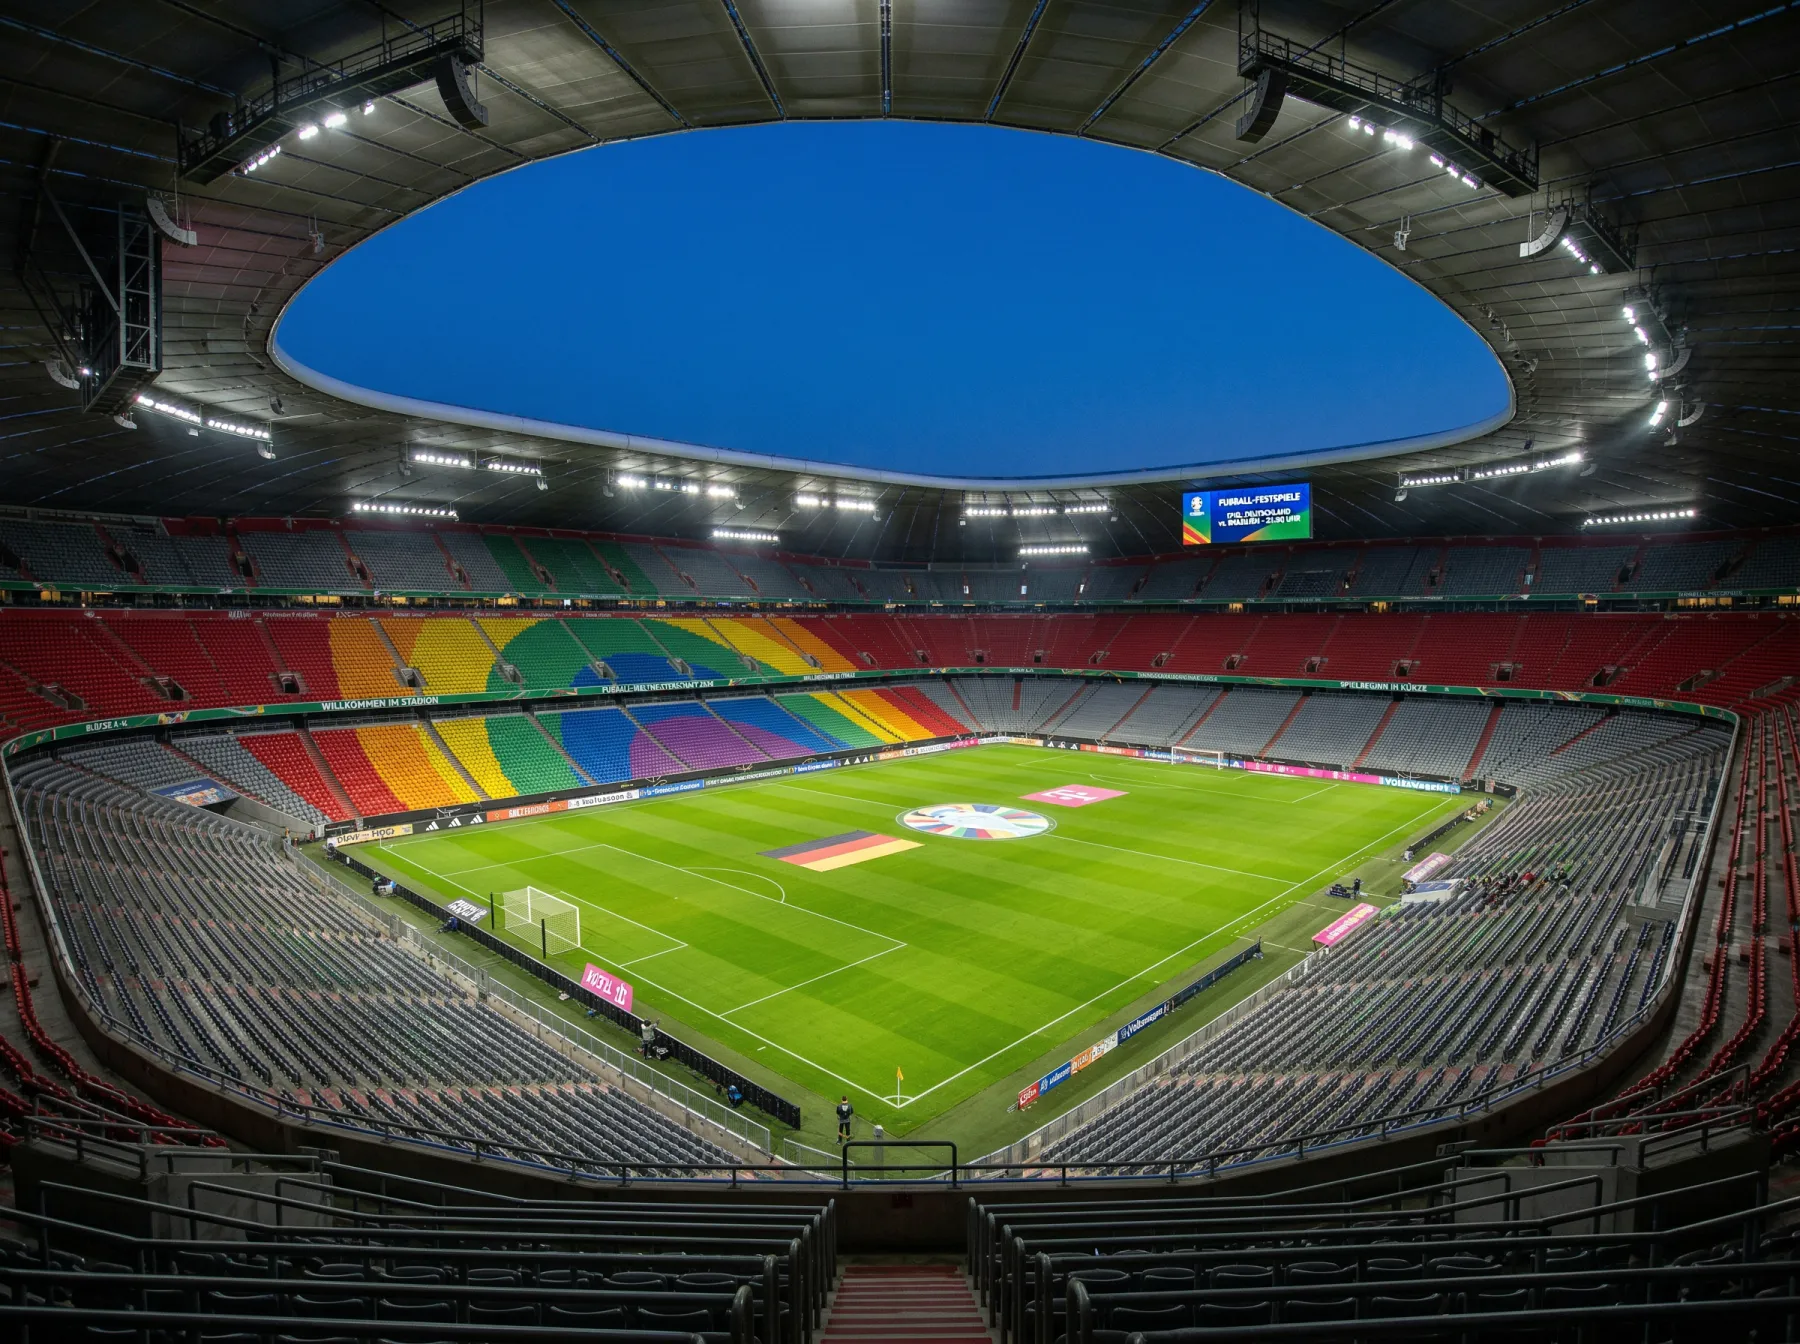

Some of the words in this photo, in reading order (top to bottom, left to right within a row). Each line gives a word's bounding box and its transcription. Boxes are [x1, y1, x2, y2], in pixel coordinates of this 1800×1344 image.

[321, 699, 386, 711] WILLKOMMEN
[388, 698, 399, 707] IM
[401, 696, 439, 706] STADION
